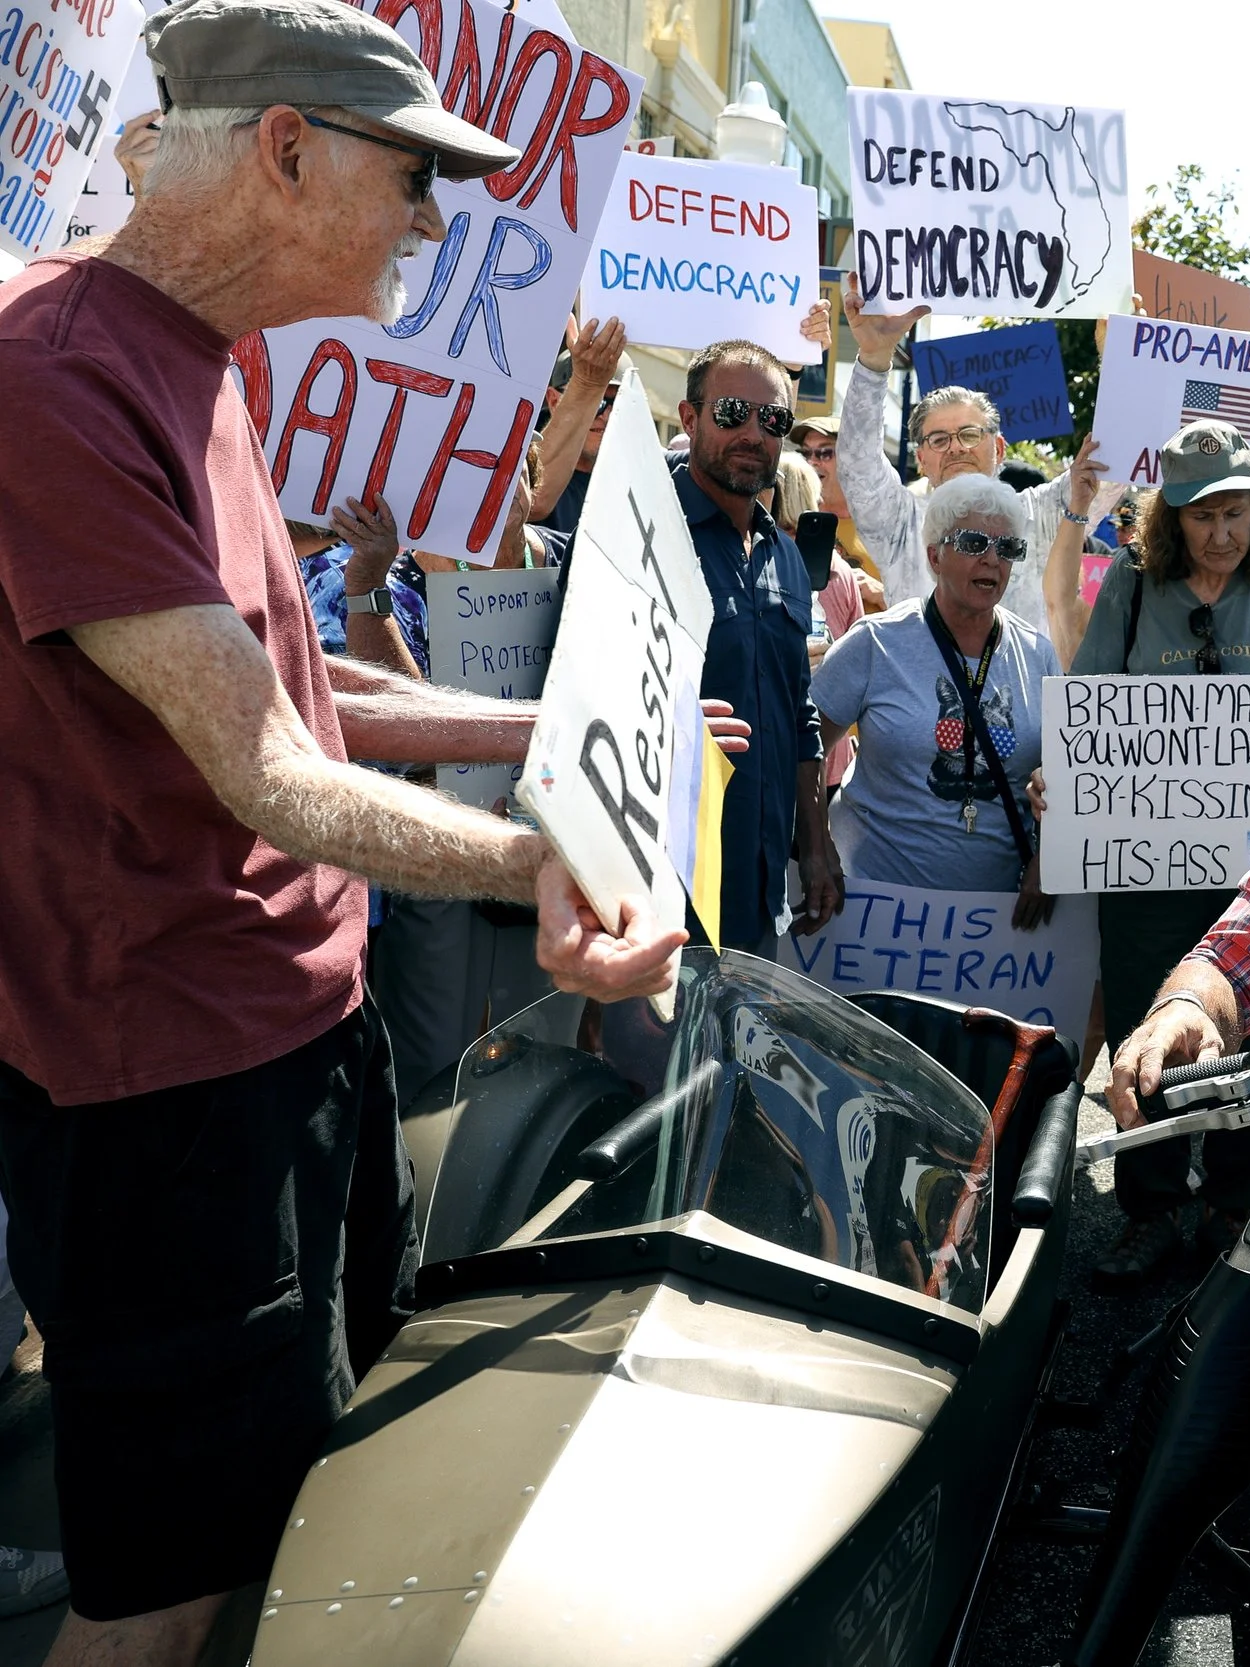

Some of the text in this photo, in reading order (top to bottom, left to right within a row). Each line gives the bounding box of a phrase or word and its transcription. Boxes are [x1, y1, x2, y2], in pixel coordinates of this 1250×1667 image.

[864, 138, 999, 192] DEFEND
[629, 179, 790, 241] DEFEND
[600, 248, 800, 306] DEMOCRACY
[857, 224, 1064, 309] DEMOCRACY
[917, 345, 1054, 385] DEMOCRACY
[975, 374, 1013, 398] NOT
[457, 586, 552, 618] SUPPORT OUR
[580, 486, 677, 894] Resist
[845, 892, 997, 942] THIS
[790, 935, 1055, 993] VETERAN
